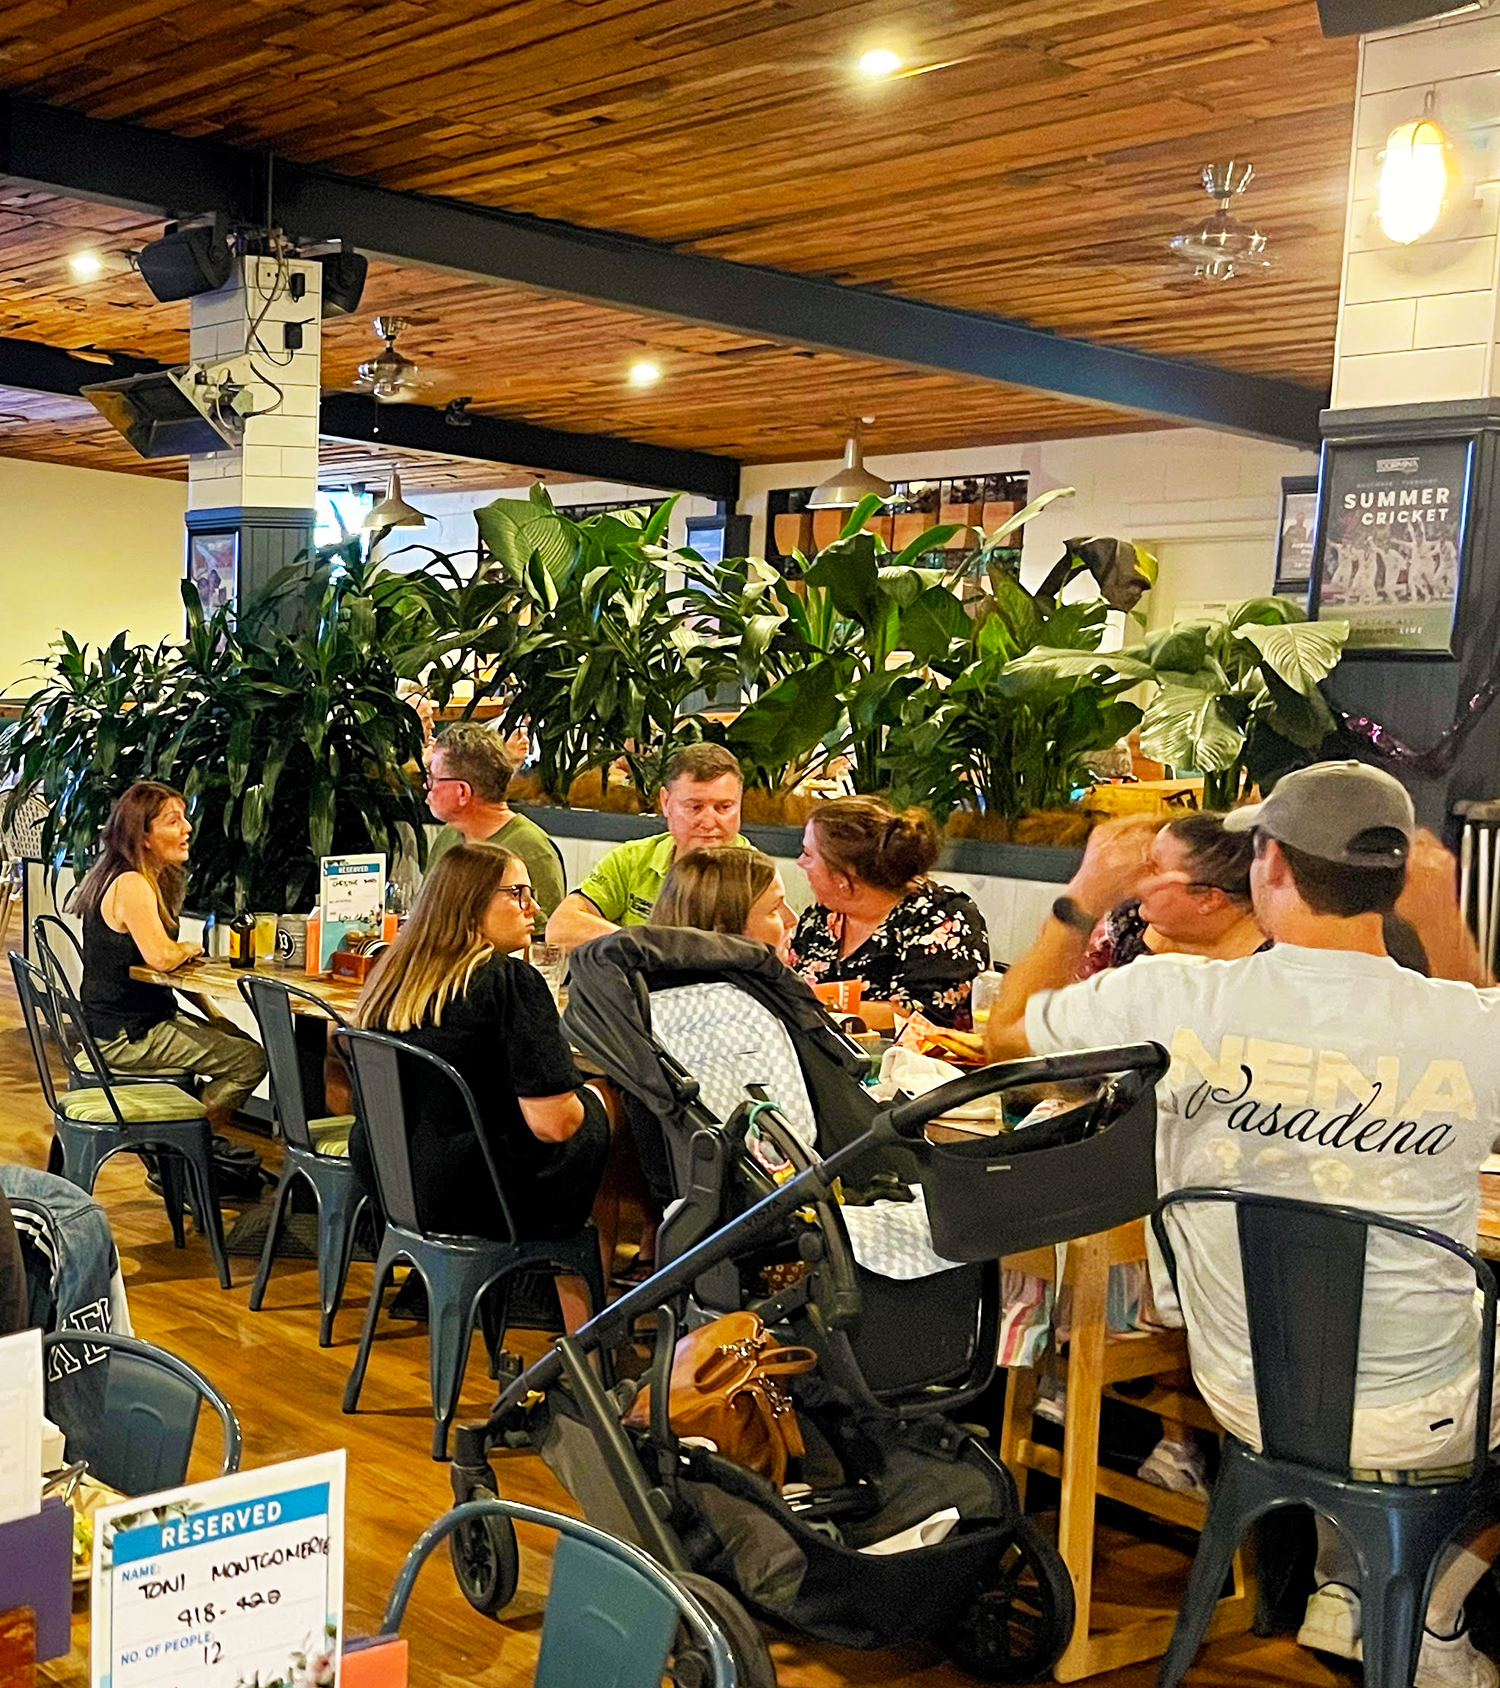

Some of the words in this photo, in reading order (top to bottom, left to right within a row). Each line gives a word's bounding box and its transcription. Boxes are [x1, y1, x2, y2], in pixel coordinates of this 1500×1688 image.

[1344, 487, 1450, 510] SUMMER
[1361, 508, 1449, 525] CRICKET
[1185, 1064, 1457, 1156] Pasadena
[161, 1501, 282, 1549] RESERVED
[138, 1573, 186, 1600] TONI
[145, 1645, 161, 1658] OF
[203, 1641, 225, 1665] 12
